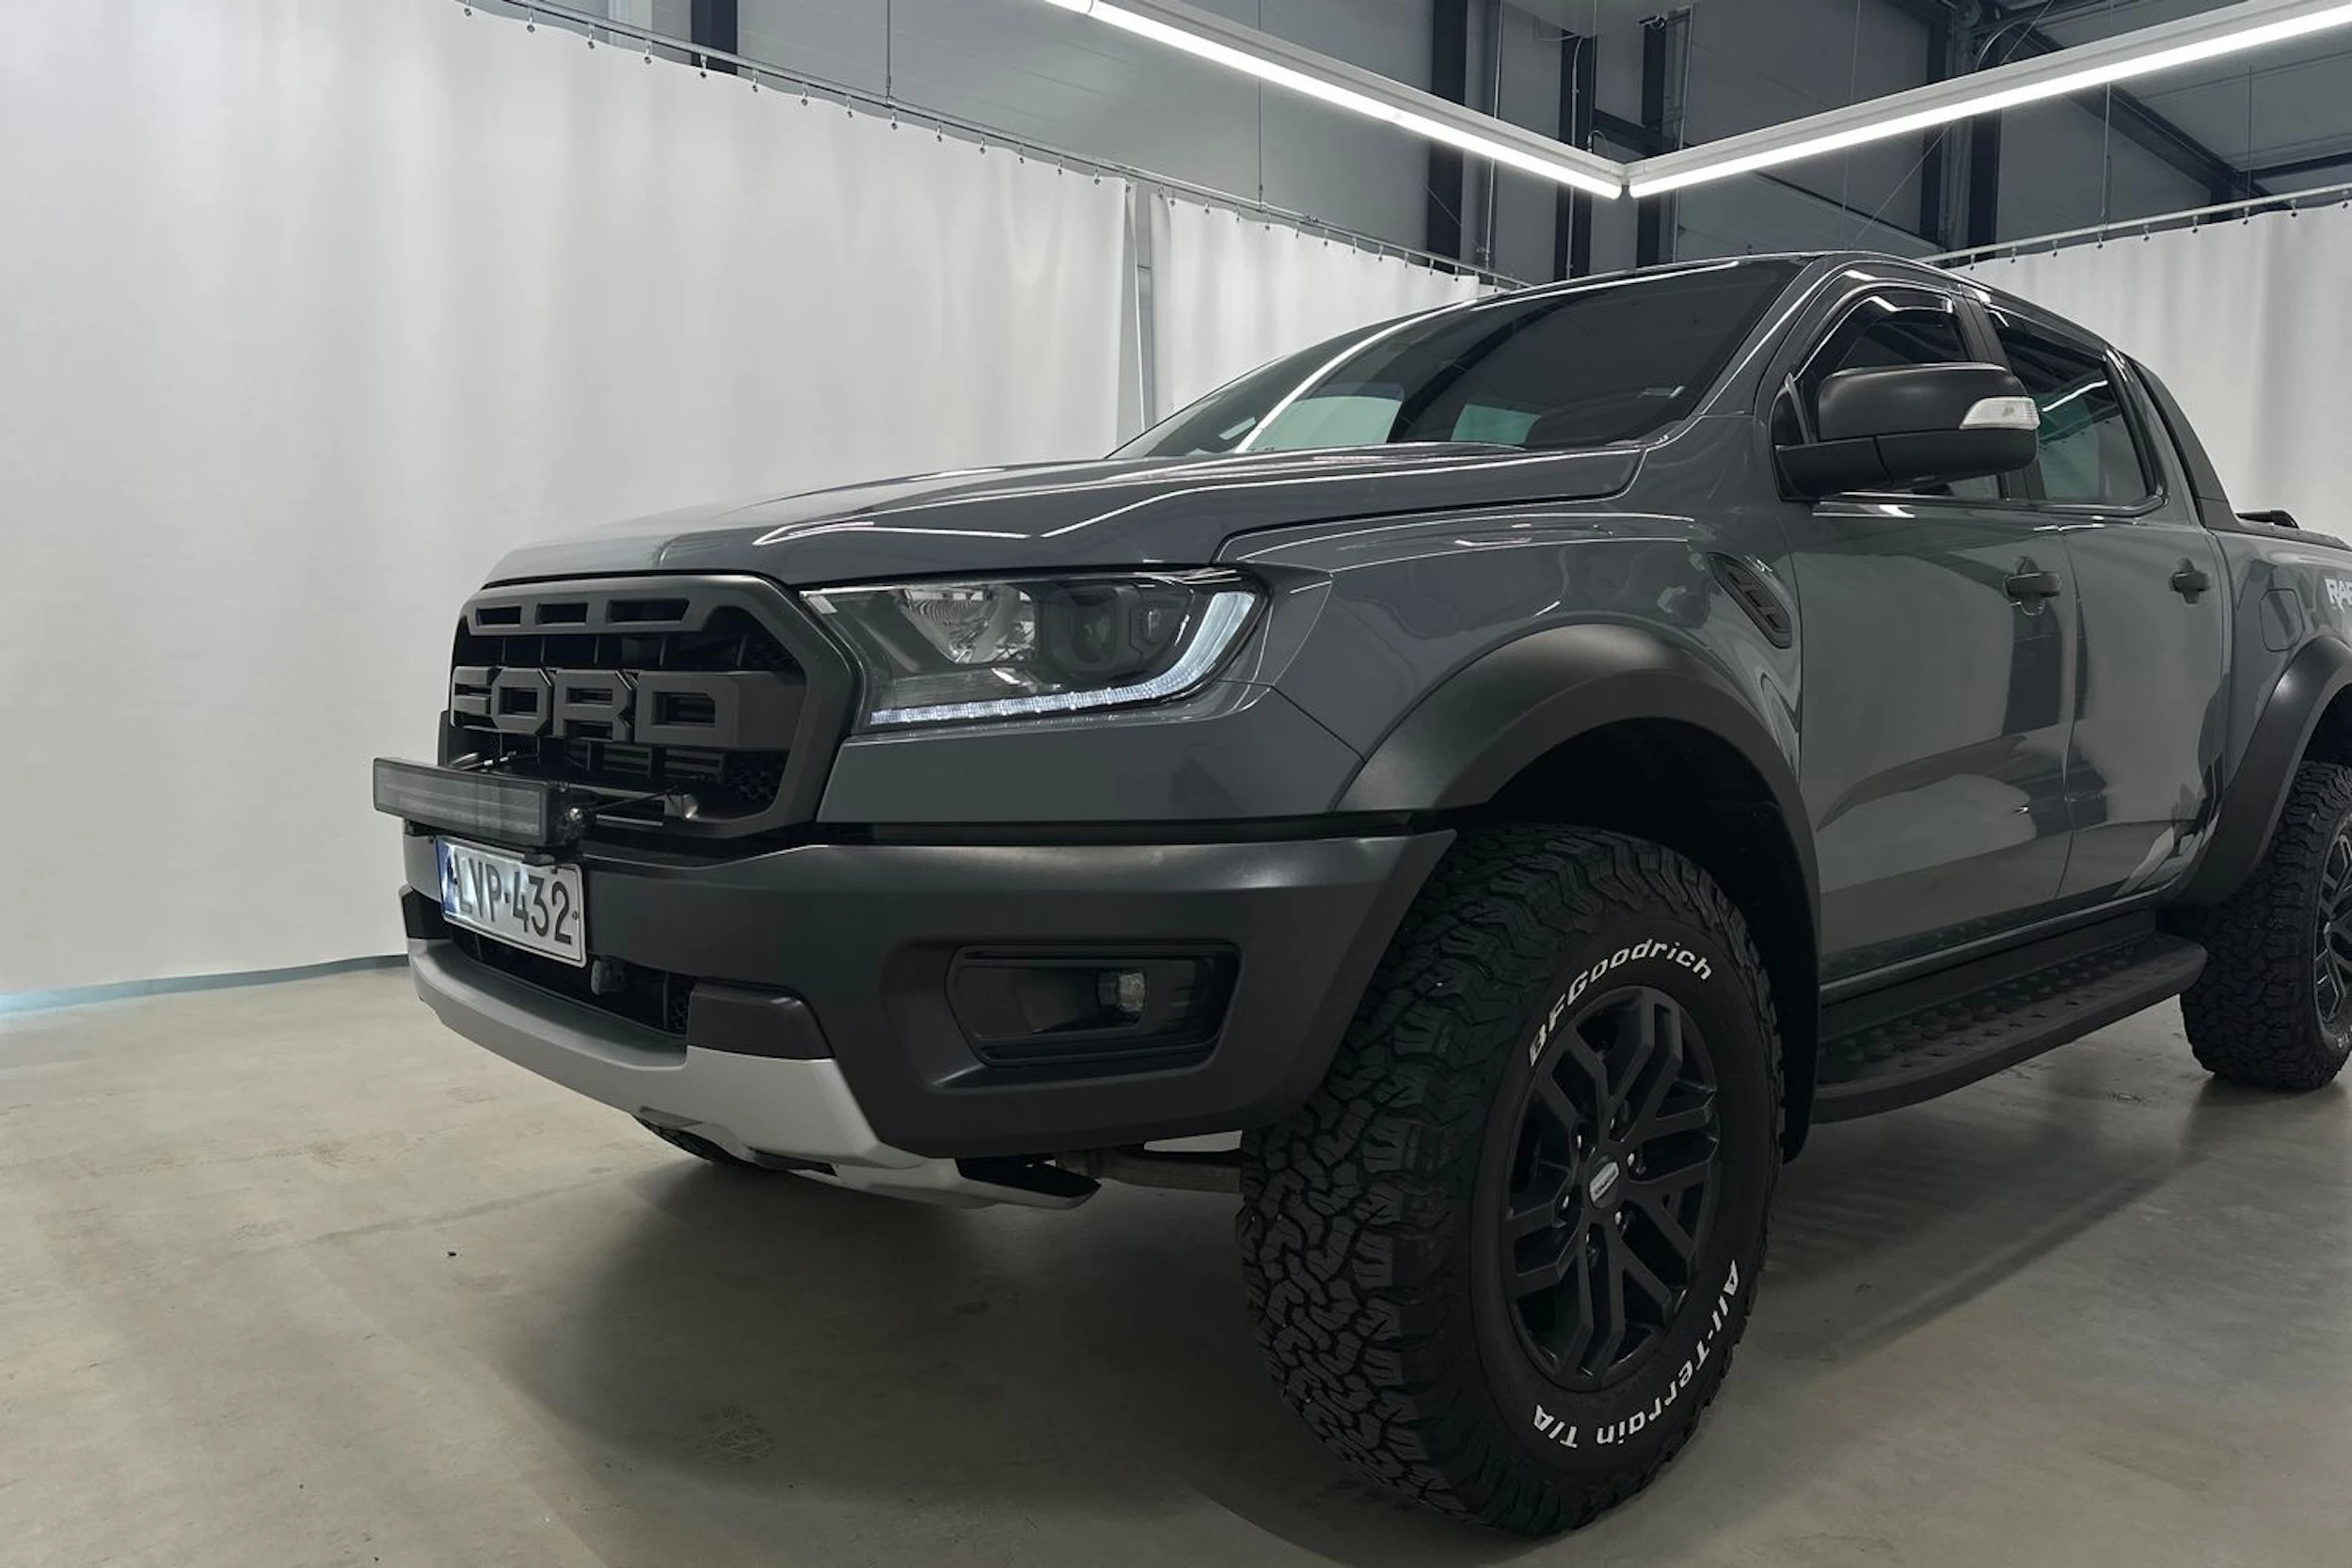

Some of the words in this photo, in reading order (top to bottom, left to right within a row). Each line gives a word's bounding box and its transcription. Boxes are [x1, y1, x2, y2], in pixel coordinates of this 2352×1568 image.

[450, 666, 739, 746] FORD
[454, 853, 572, 944] LVP-432
[1529, 939, 1712, 1068] BFGoodrich
[1596, 1259, 1739, 1445] All-Terrain
[1534, 1404, 1578, 1449] T/A
